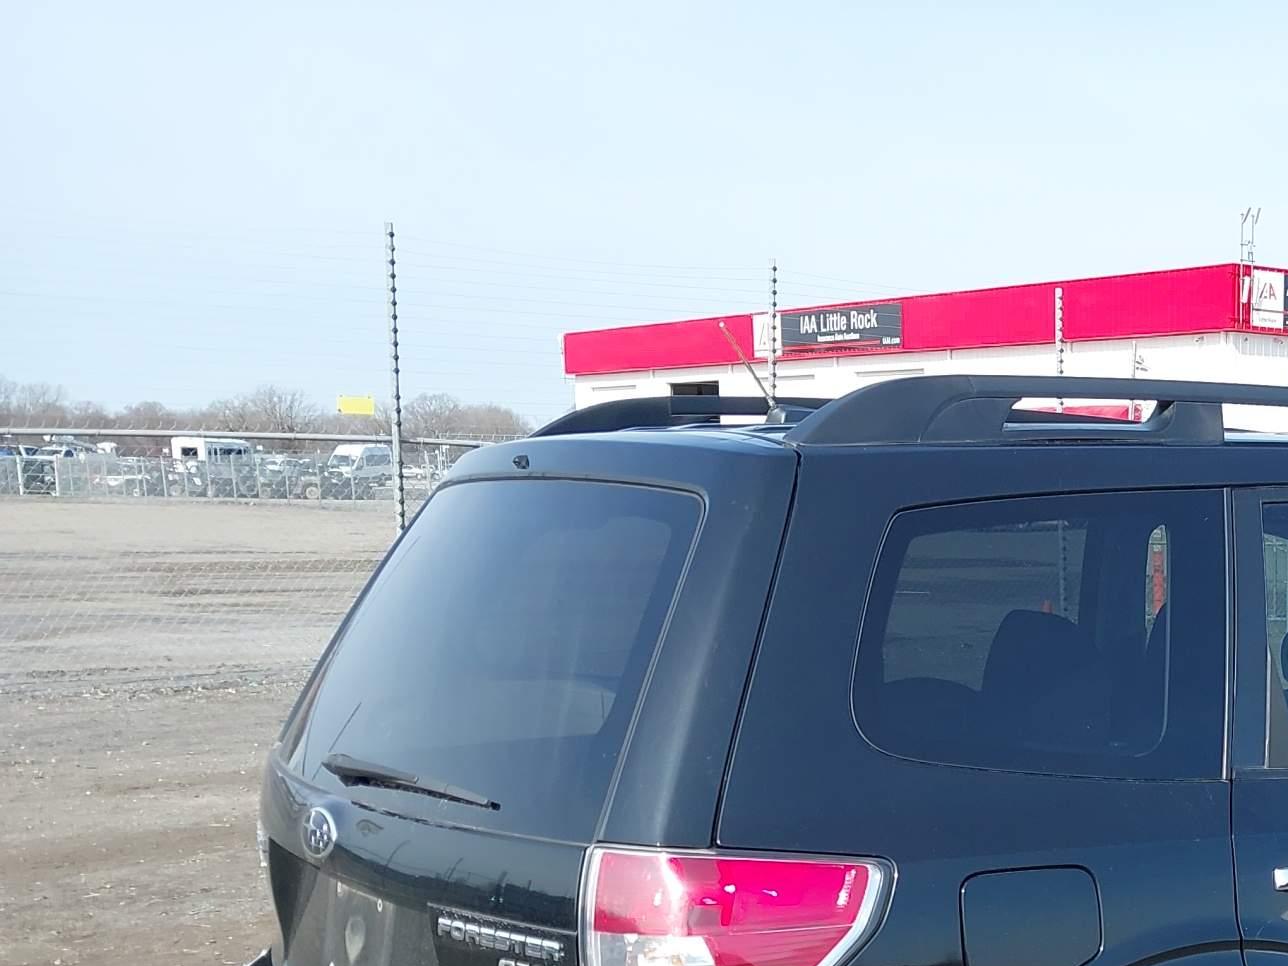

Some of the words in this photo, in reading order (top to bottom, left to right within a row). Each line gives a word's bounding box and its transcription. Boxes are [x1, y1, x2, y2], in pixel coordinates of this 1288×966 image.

[800, 315, 818, 334] IAA
[820, 313, 847, 332] Little
[850, 309, 878, 330] Rock
[437, 917, 561, 962] FORESTER
